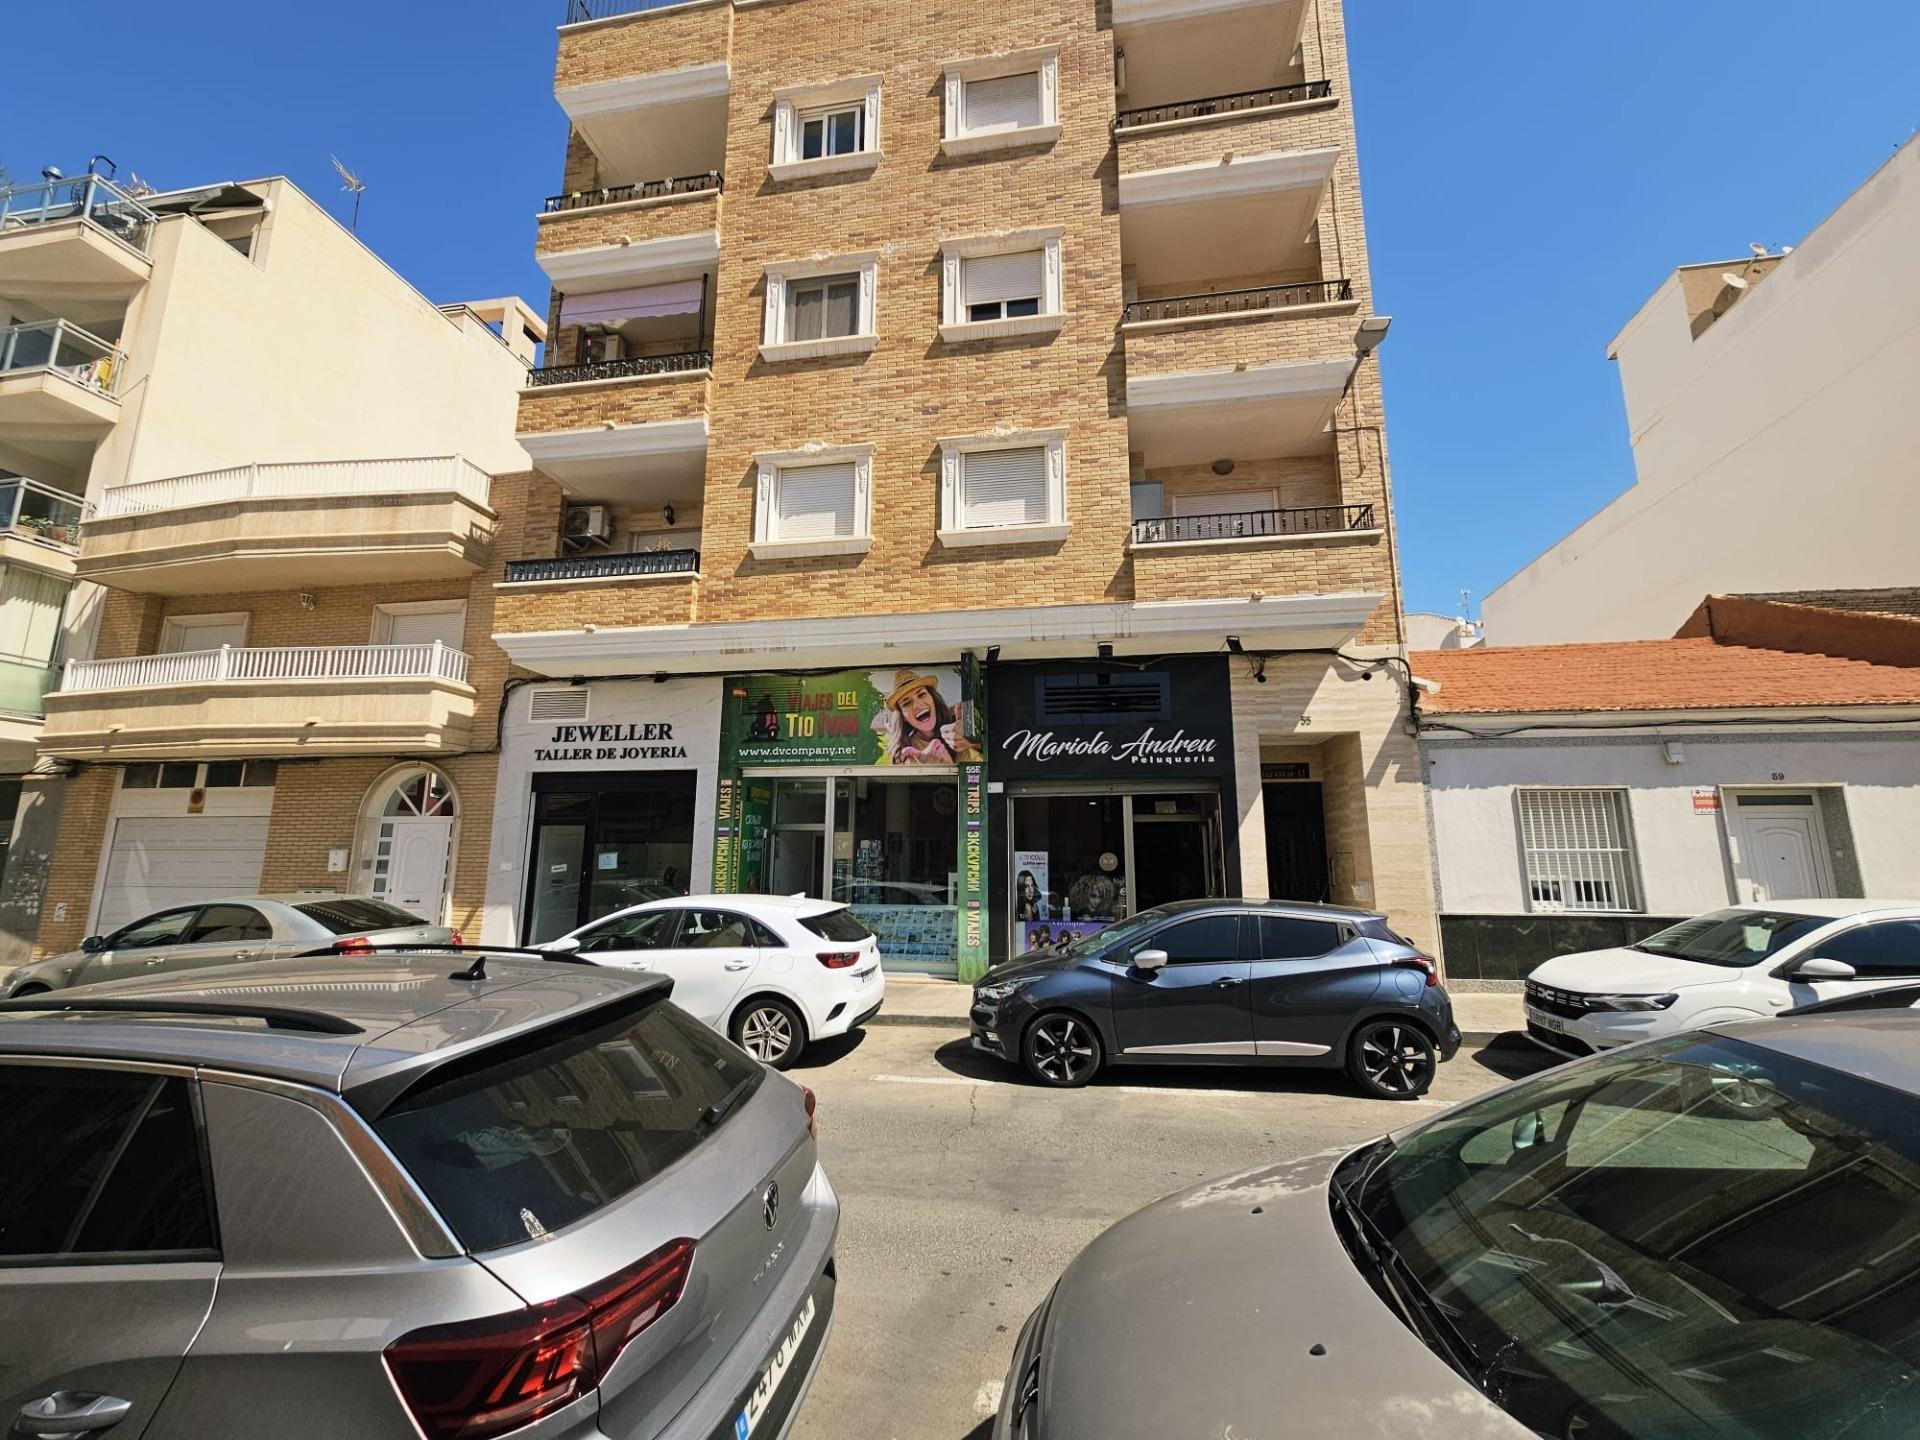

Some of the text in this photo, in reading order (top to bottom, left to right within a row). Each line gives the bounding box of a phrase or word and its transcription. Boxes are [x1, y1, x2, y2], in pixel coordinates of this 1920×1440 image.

[837, 690, 859, 706] DEL
[785, 713, 815, 738] TIO
[1300, 715, 1312, 726] 55
[552, 723, 674, 743] JEWELLER
[535, 746, 688, 761] TALLER DE JOYERIA
[738, 745, 856, 758] www.dvcompany.net
[1002, 727, 1218, 762] Mariola Andreu
[1131, 755, 1215, 765] Peluqueria
[1771, 772, 1785, 781] 59
[719, 788, 732, 820] VIAJES
[967, 785, 981, 814] TRIPS
[715, 836, 730, 894] ЭКСКУРСИИ
[967, 832, 981, 892] ЭКСКУРСИИ
[967, 911, 981, 947] VIAJES
